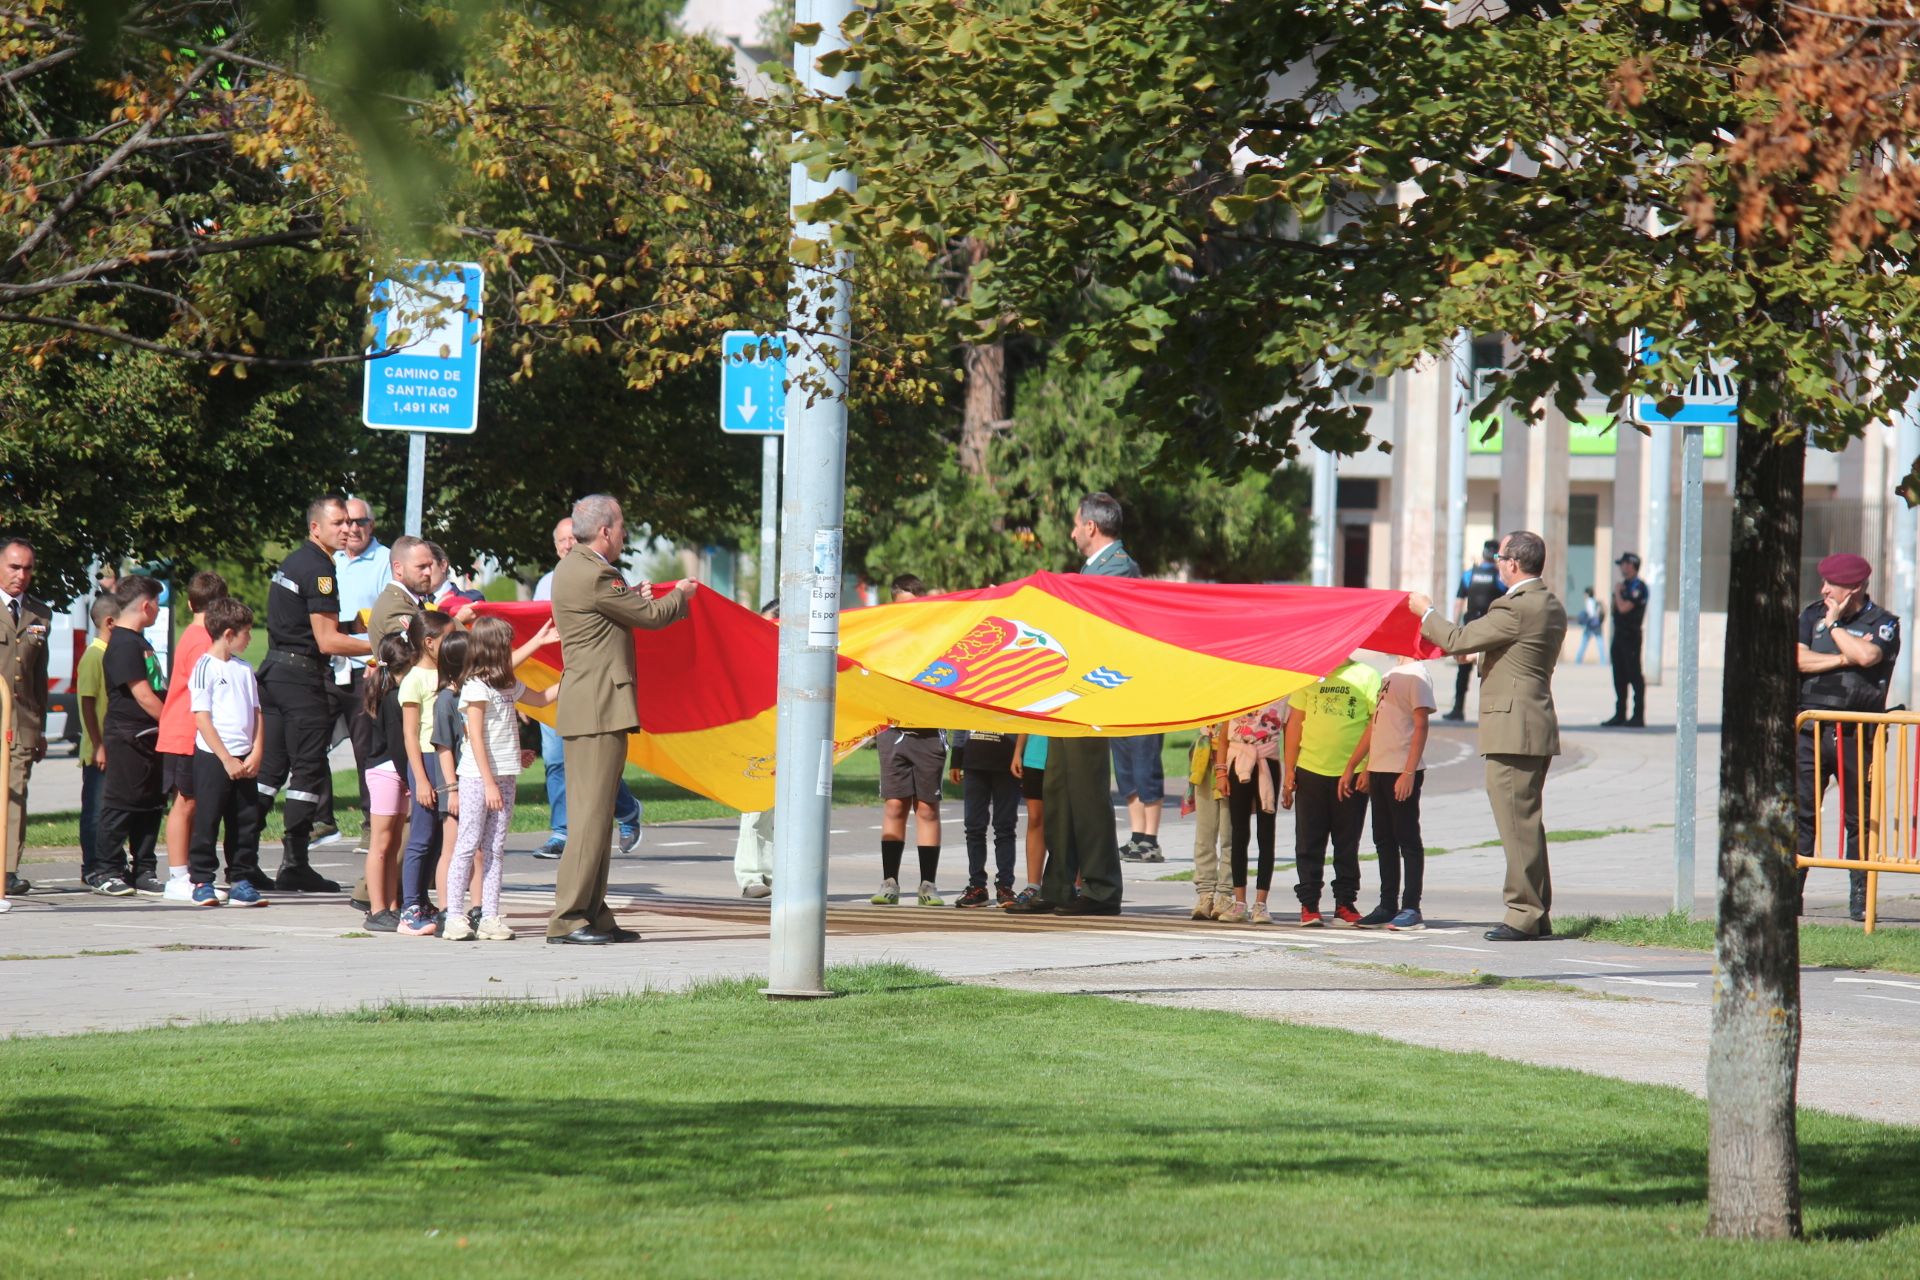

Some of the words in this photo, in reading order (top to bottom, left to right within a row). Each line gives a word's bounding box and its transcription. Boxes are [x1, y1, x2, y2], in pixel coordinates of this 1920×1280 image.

[384, 367, 439, 380] CAMINO
[444, 370, 461, 381] DE
[386, 384, 458, 398] SANTIAGO
[393, 401, 426, 414] 1,491
[430, 403, 450, 414] KM
[812, 590, 823, 599] Es
[824, 592, 837, 600] por
[811, 610, 822, 619] Es
[1319, 686, 1350, 694] BURGOS
